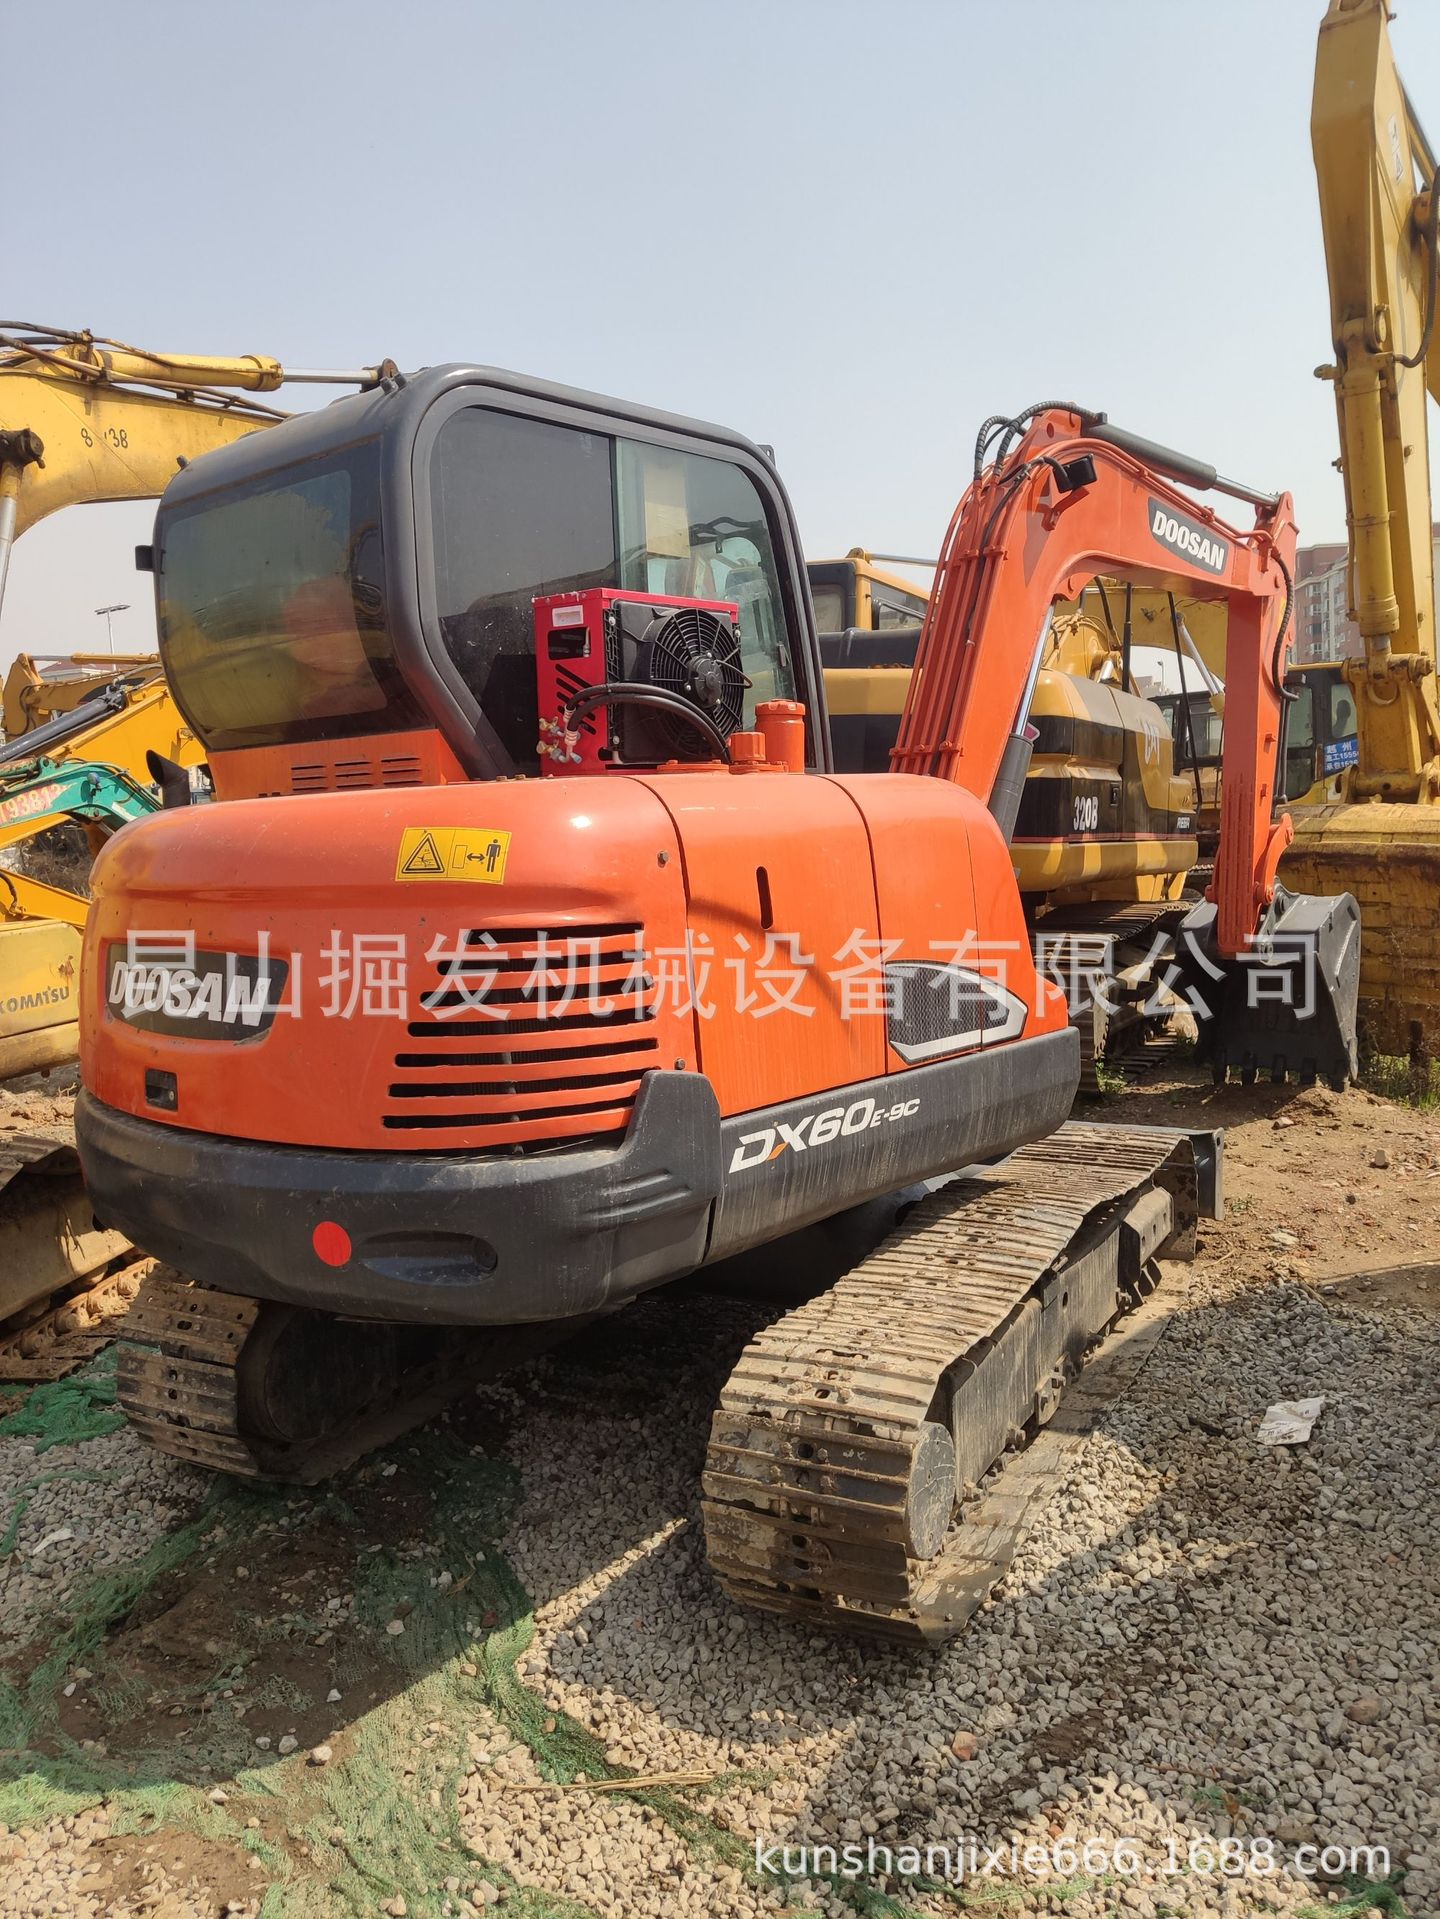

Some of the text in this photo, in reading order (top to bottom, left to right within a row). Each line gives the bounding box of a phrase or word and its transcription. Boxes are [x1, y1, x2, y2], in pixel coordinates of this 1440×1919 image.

[1152, 510, 1225, 570] DOOSAN
[1073, 795, 1099, 831] 320B
[109, 960, 272, 1027] DOOSAN
